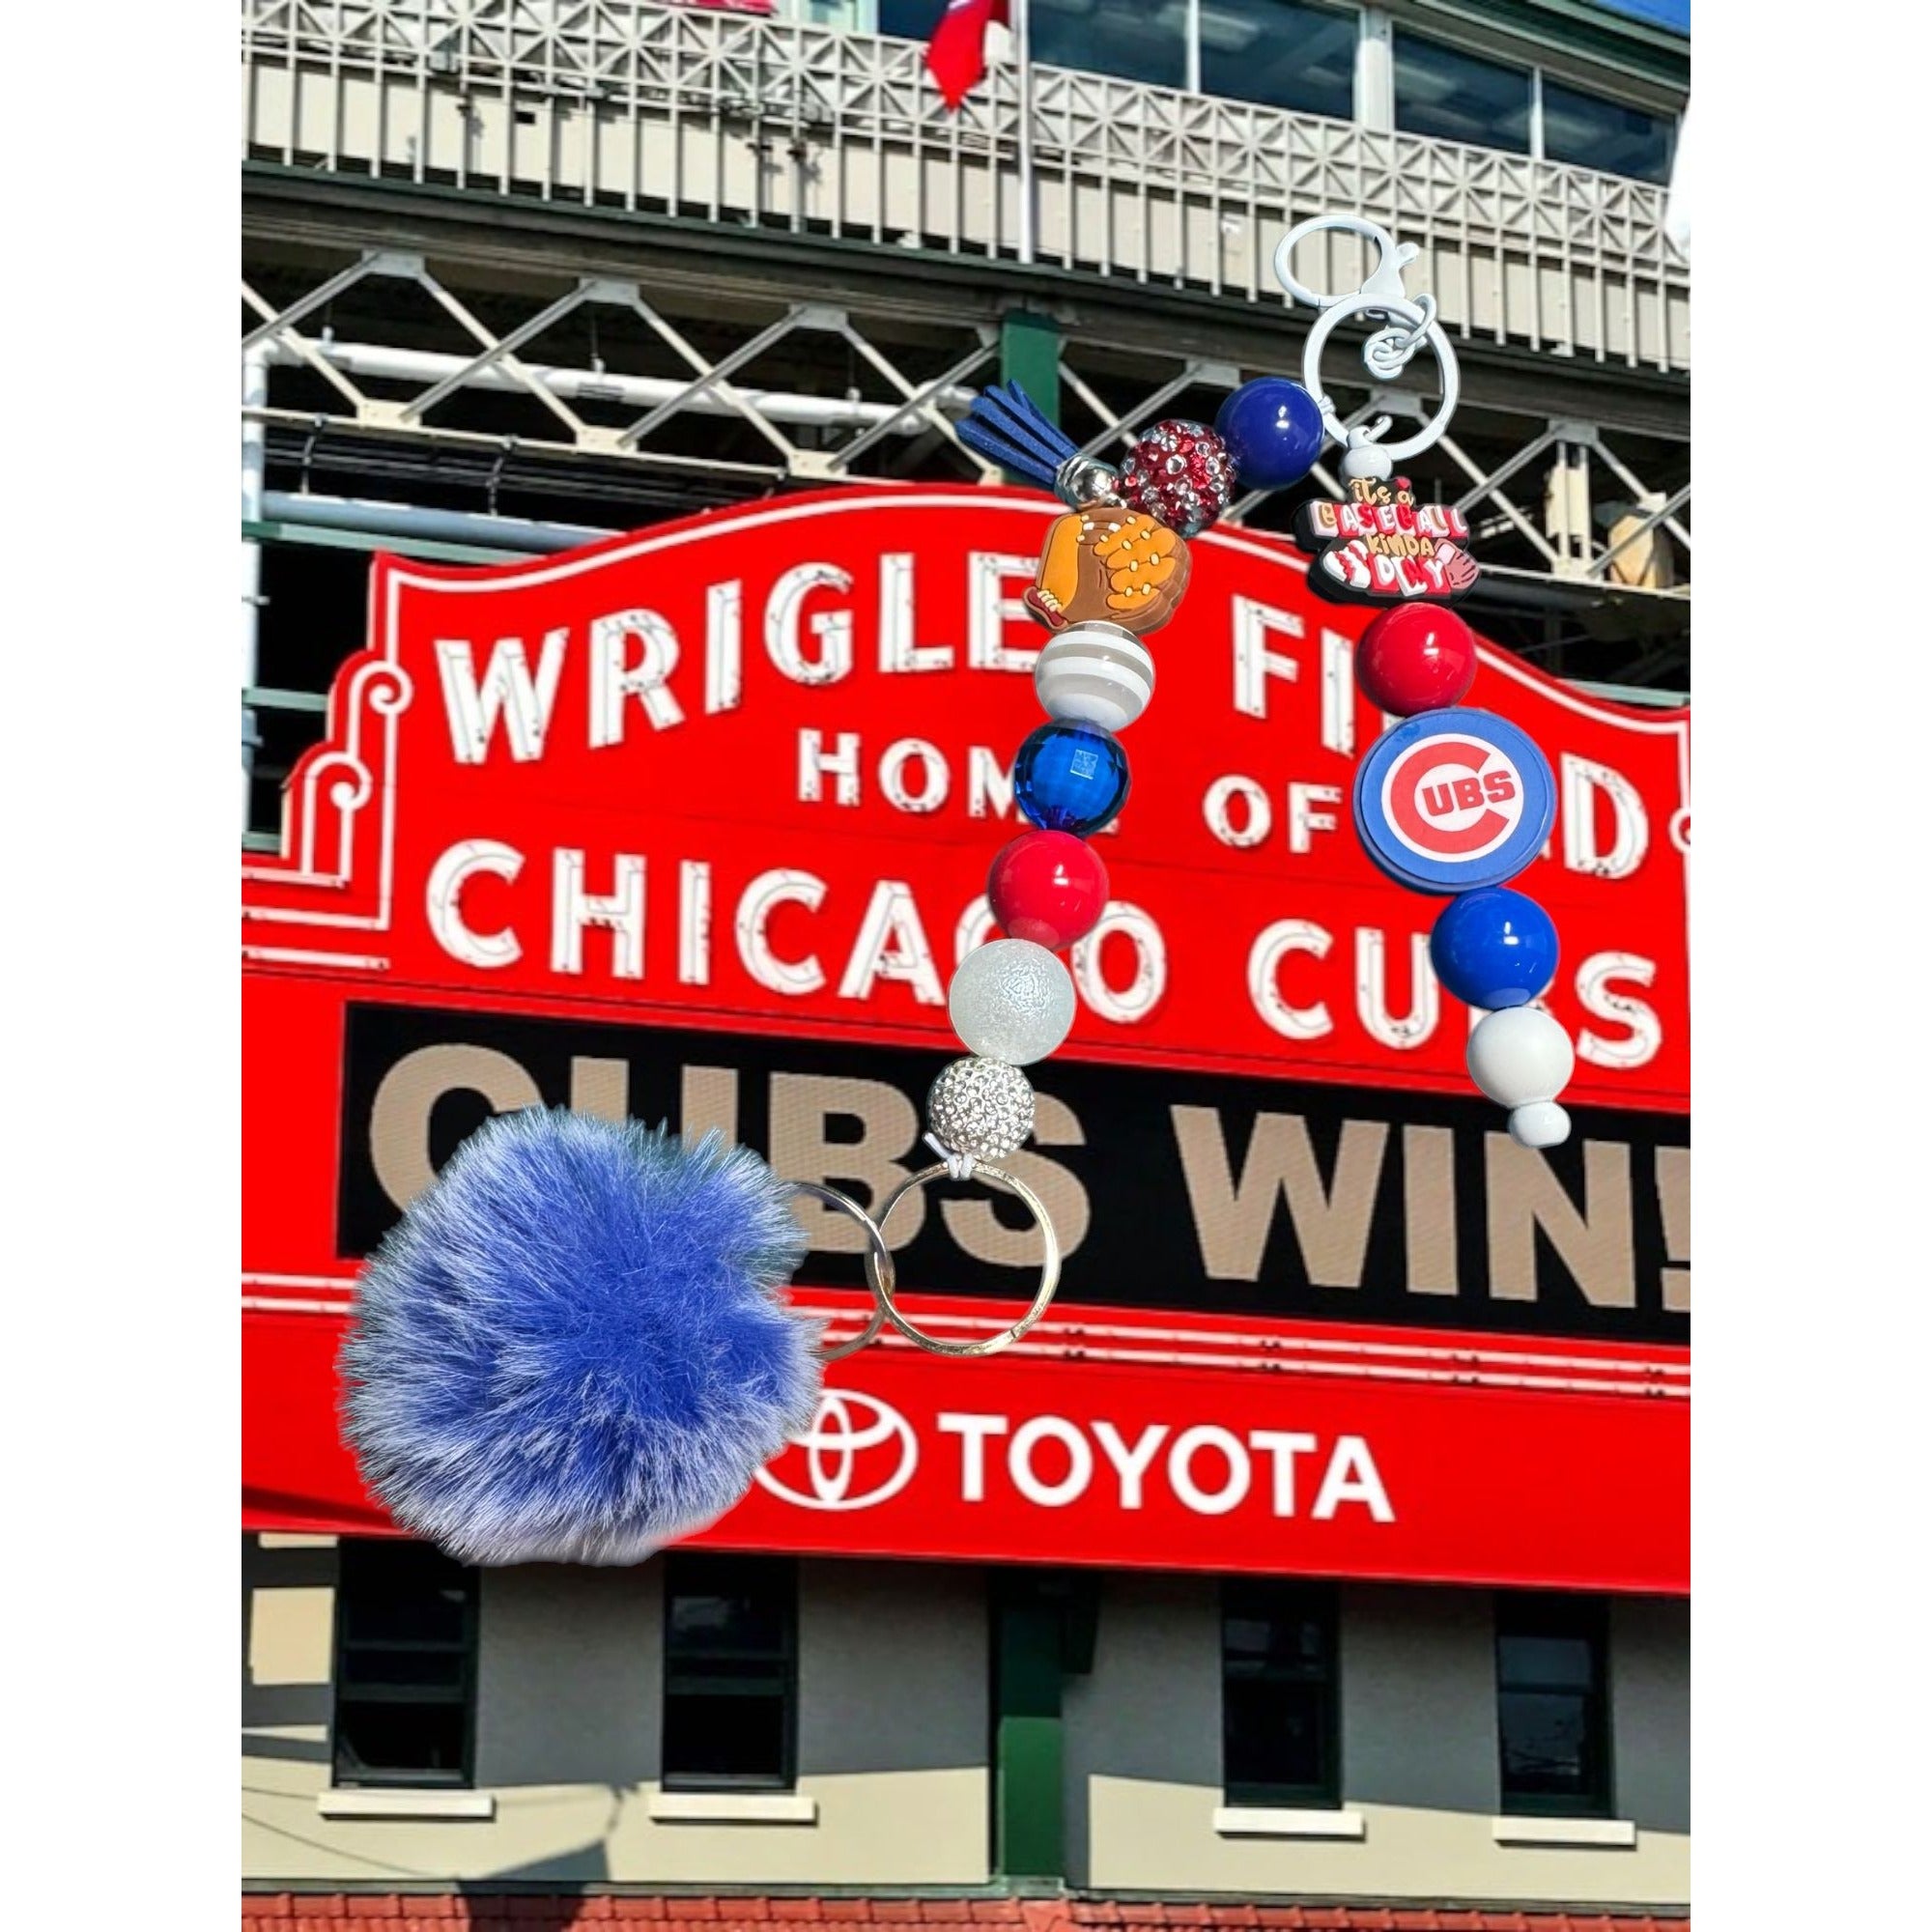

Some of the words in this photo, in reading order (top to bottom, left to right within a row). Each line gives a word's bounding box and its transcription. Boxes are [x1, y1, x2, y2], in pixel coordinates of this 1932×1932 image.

[1316, 501, 1468, 535] BASEBALL
[1374, 555, 1447, 591] DAY
[434, 551, 1040, 765] WRIGLE
[1233, 593, 1650, 880] FID
[798, 726, 1119, 835] HOM
[1203, 775, 1344, 855] OF
[1390, 741, 1516, 855] CUBS
[1246, 919, 1662, 1070] CUS
[938, 1411, 1396, 1523] TOYOTA
